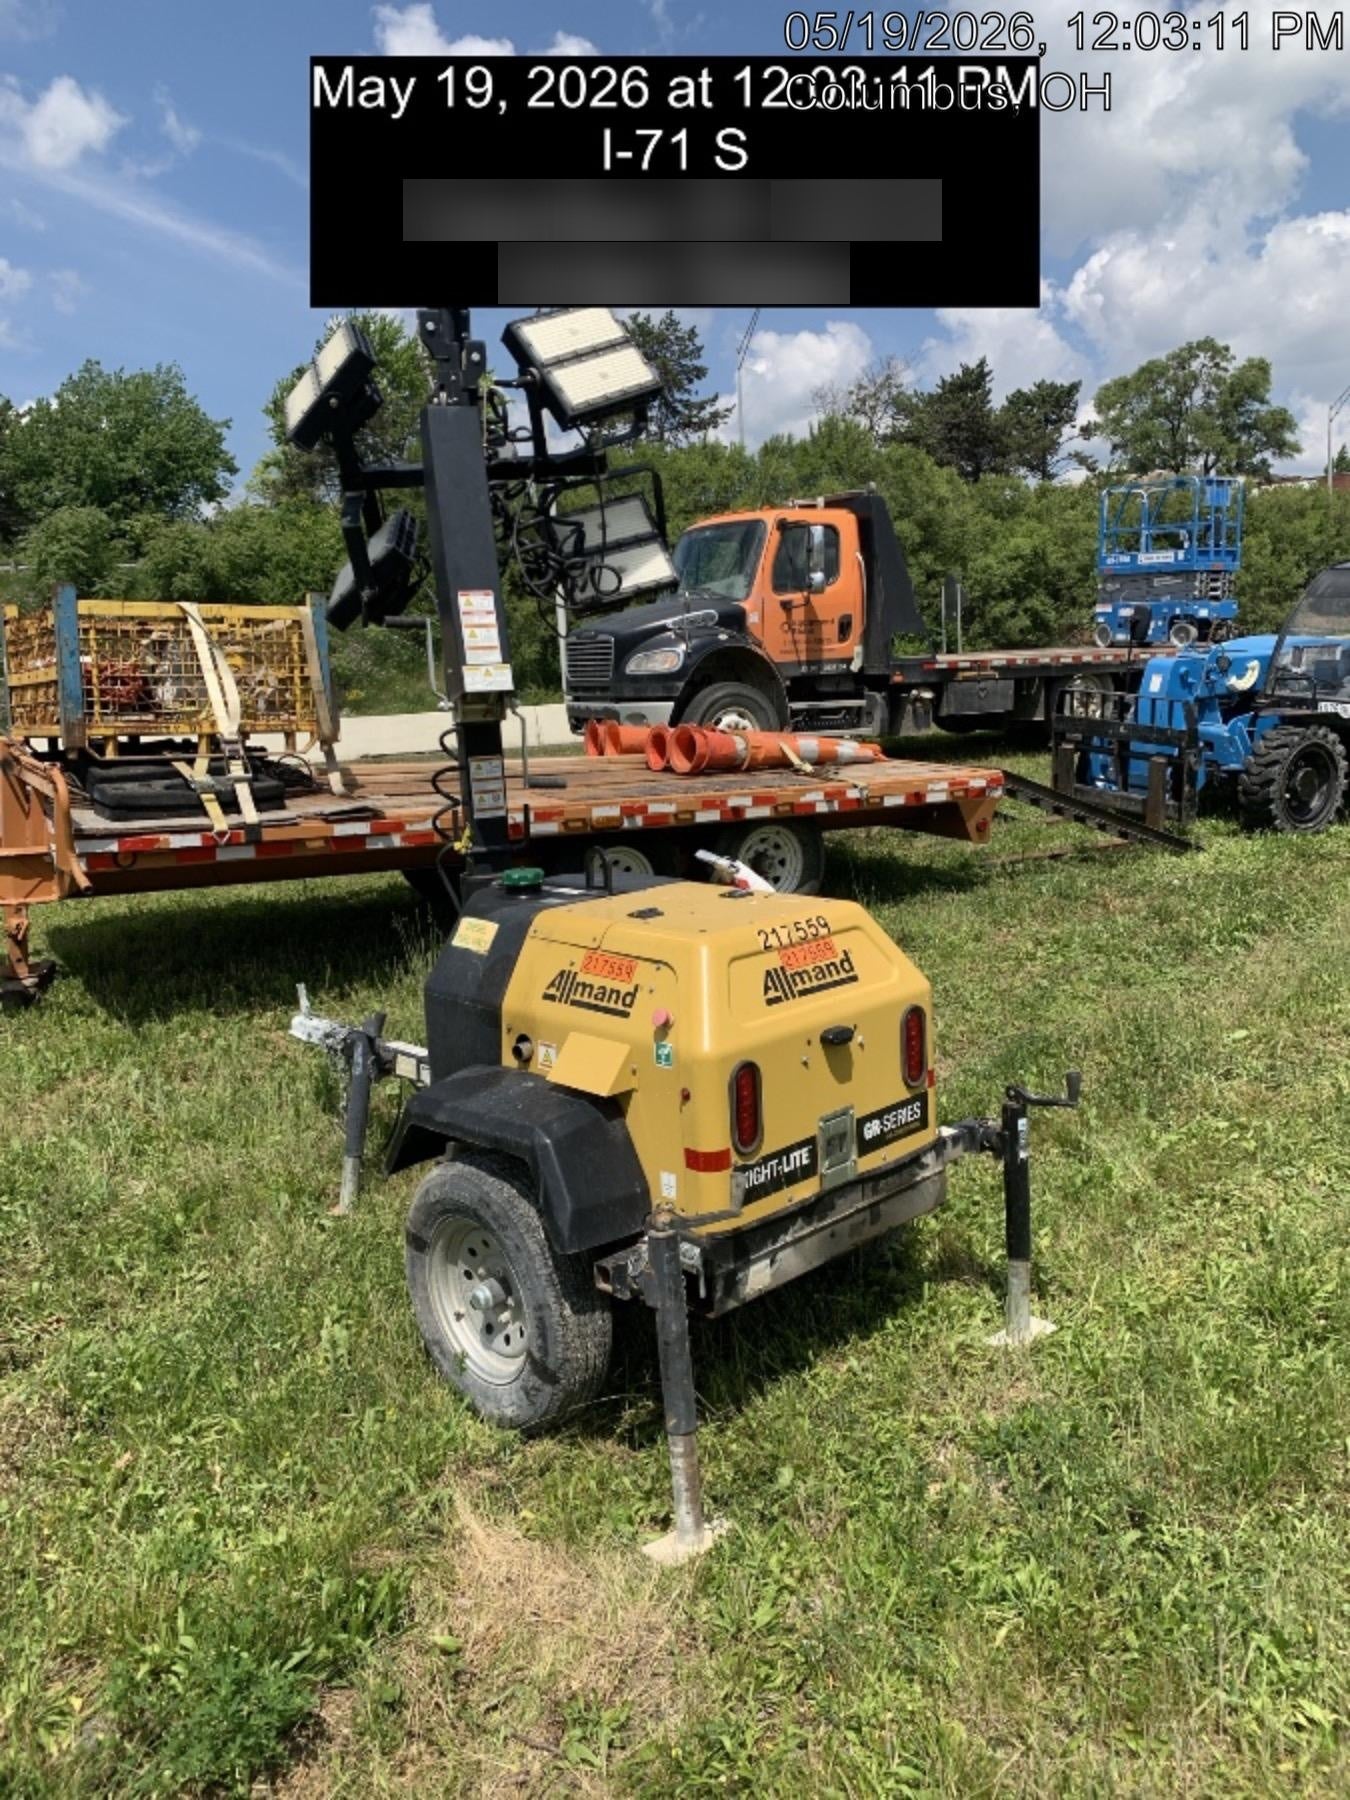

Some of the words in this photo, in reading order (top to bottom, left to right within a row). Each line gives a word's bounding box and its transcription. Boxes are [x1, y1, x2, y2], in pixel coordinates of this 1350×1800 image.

[757, 915, 832, 950] 217559
[583, 955, 633, 979] 217559
[763, 949, 856, 1002] Allmand
[544, 969, 639, 1010] Allmand
[863, 1101, 921, 1140] GR-SERIES
